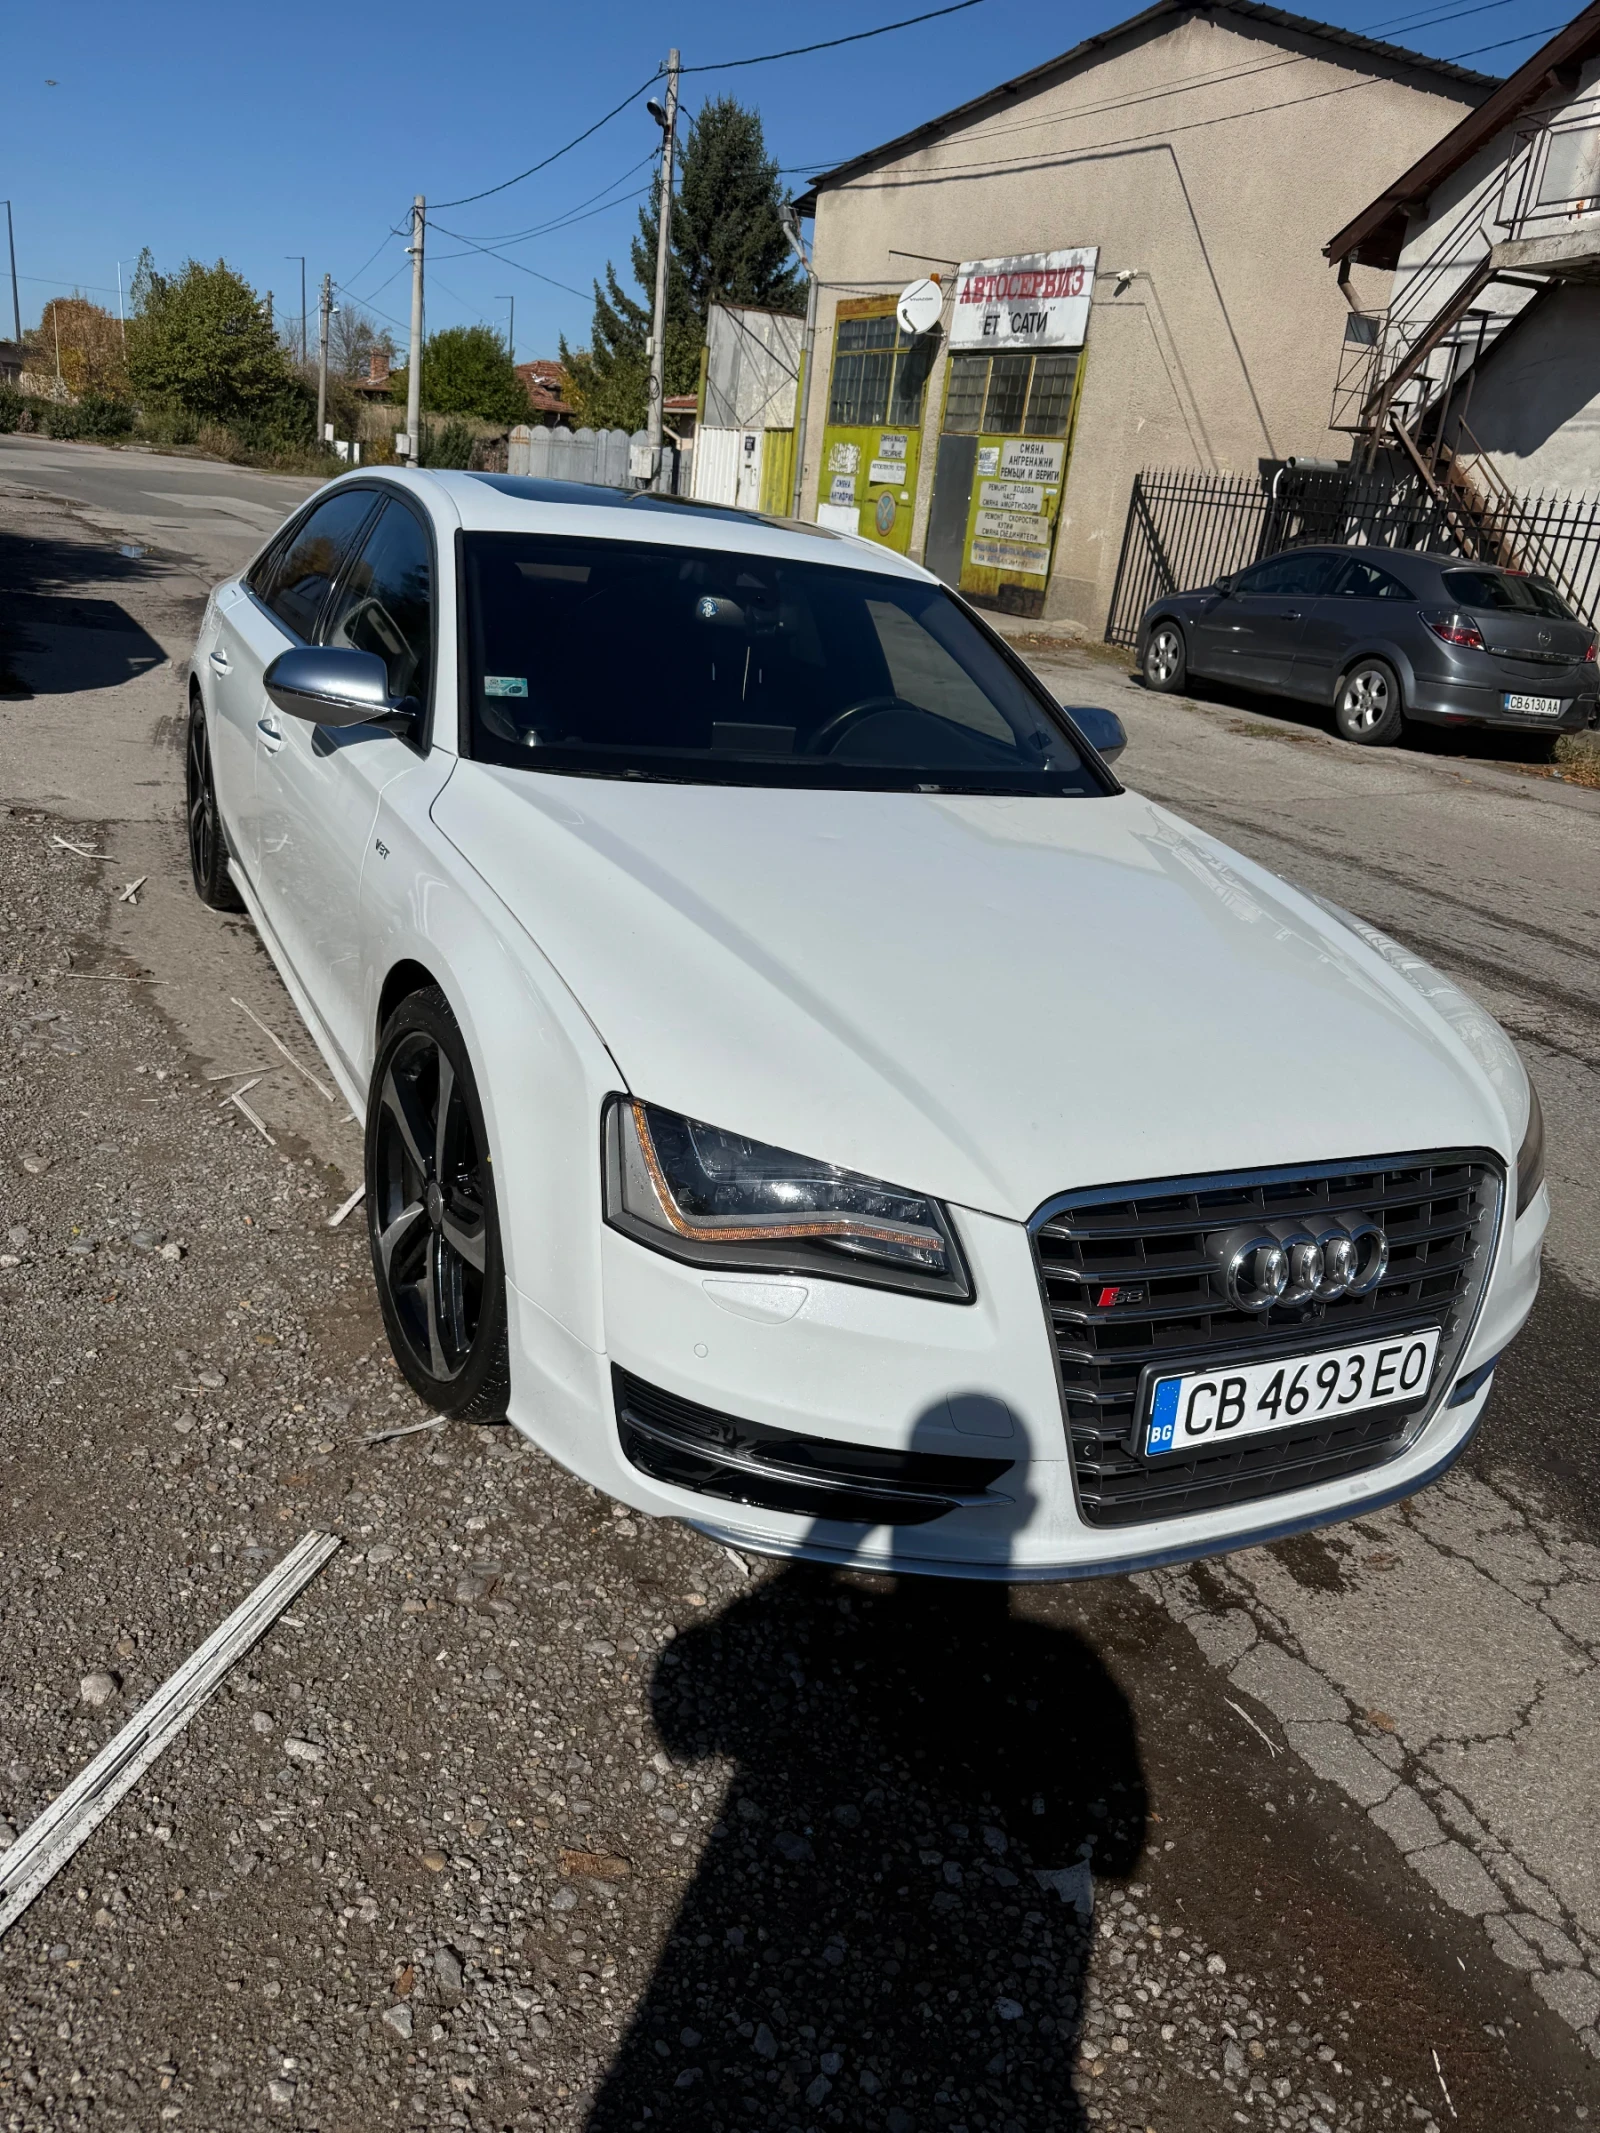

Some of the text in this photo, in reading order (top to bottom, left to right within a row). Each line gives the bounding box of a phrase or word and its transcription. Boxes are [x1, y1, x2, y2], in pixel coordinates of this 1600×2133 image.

[959, 265, 1085, 304] АВТОСЕРВИЗ
[983, 315, 1000, 335] ЕТ
[1020, 443, 1044, 454] СМЯНА
[1008, 456, 1053, 468] АНГРЕНАЖНИ
[1000, 467, 1060, 481] РЕМЪЦИ И ВЕРИГИ
[988, 483, 1034, 494] РЕМОНТ ХОДОВА
[982, 499, 998, 507] СМЯНА
[985, 513, 1039, 525] РЕМОНТ СКОРОСТНИ
[982, 528, 1038, 541] СМЯНА СЪЕДИНИТЕЛИ
[1510, 696, 1558, 712] CB 6130 AA
[1185, 1376, 1247, 1436] CB
[1257, 1354, 1365, 1421] 4693
[1150, 1425, 1172, 1443] BG
